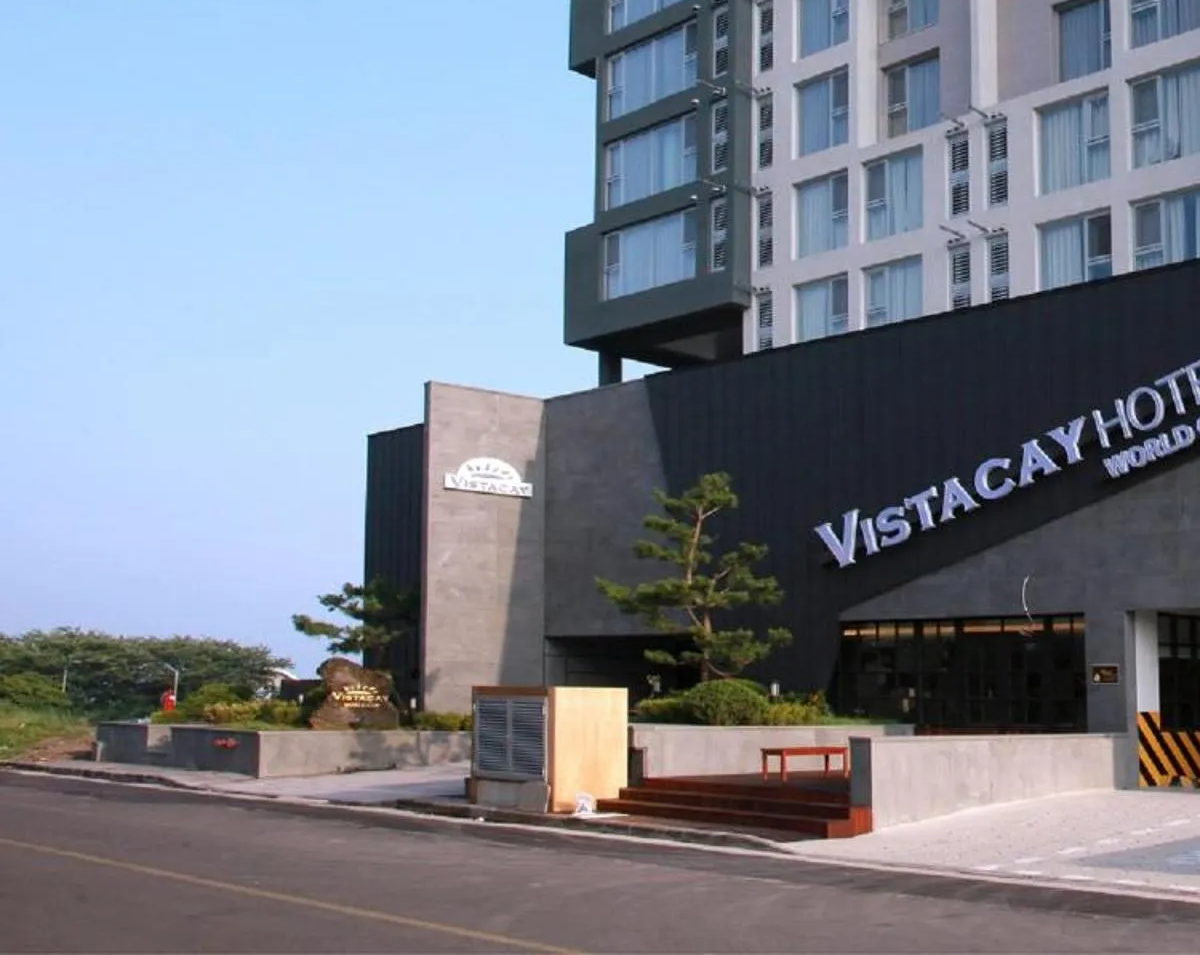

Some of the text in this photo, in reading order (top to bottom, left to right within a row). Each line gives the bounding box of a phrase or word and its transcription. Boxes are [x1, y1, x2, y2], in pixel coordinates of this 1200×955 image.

[1103, 424, 1196, 478] WORLD
[450, 477, 529, 494] VISTACAY
[814, 416, 1086, 567] VISTACAY
